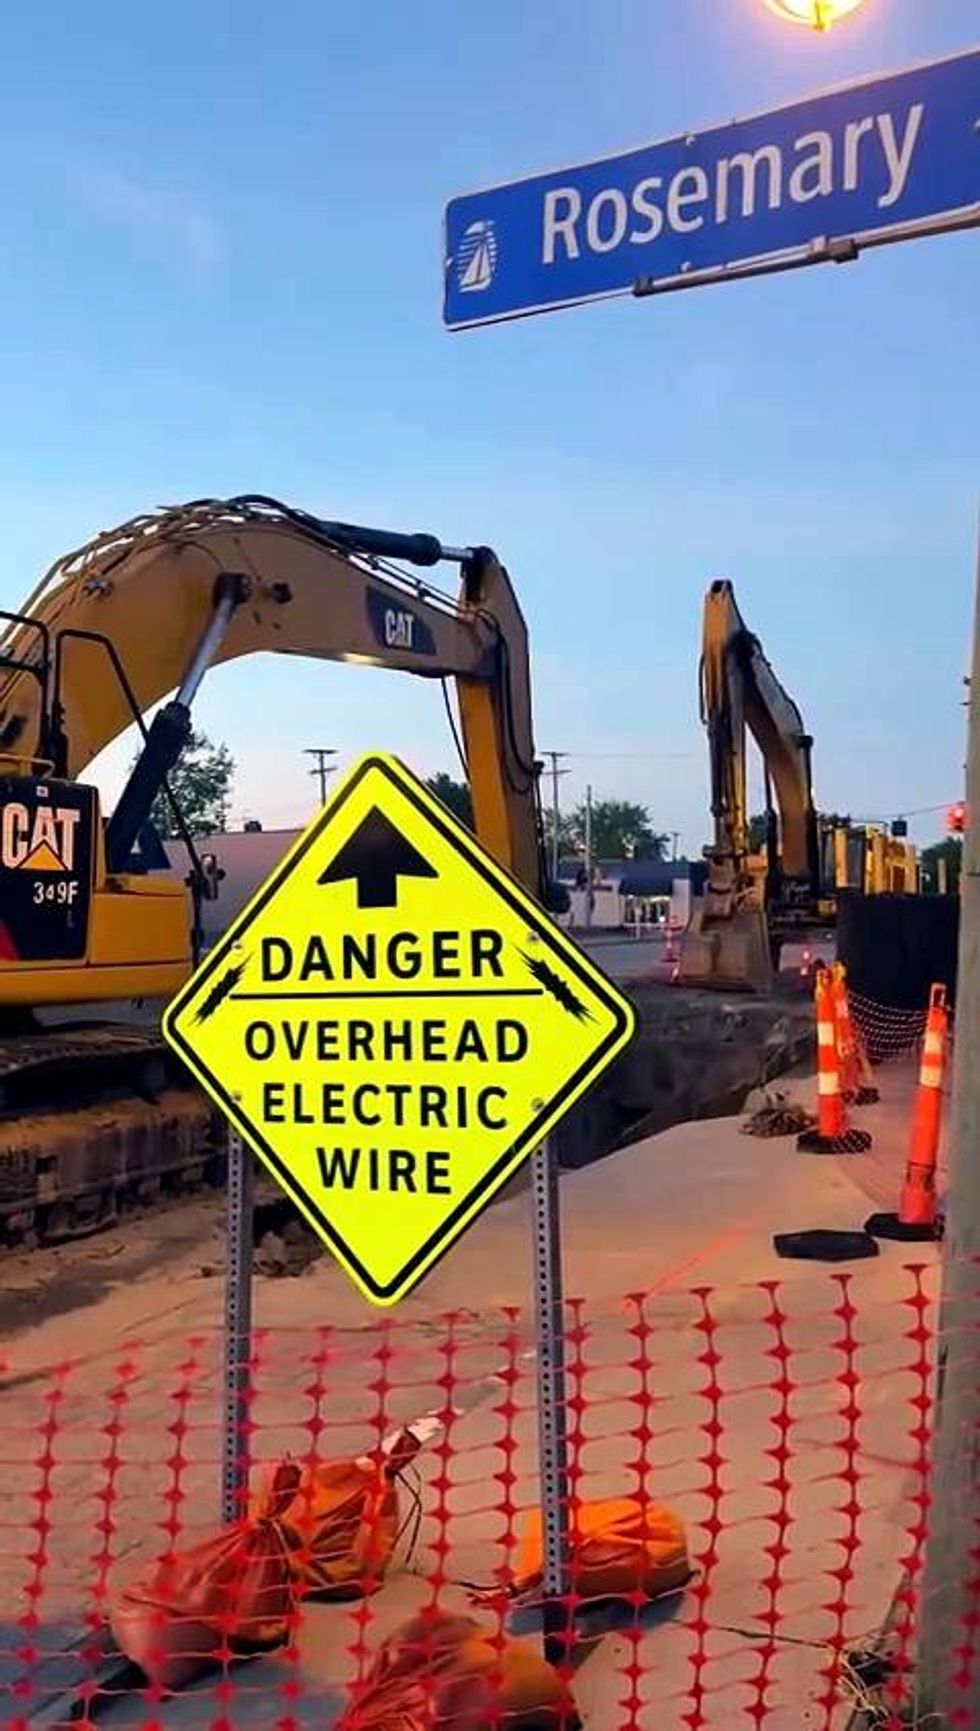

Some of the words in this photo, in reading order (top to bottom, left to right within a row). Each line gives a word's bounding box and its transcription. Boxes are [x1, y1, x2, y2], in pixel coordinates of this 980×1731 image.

[541, 103, 924, 264] Rosemary
[385, 609, 414, 648] CAT
[2, 802, 81, 871] CAT
[33, 881, 79, 905] 349F
[261, 928, 504, 982] DANGER
[245, 1019, 529, 1062] OVERHEAD
[263, 1082, 508, 1130] ELECTRIC
[317, 1147, 452, 1194] WIRE
